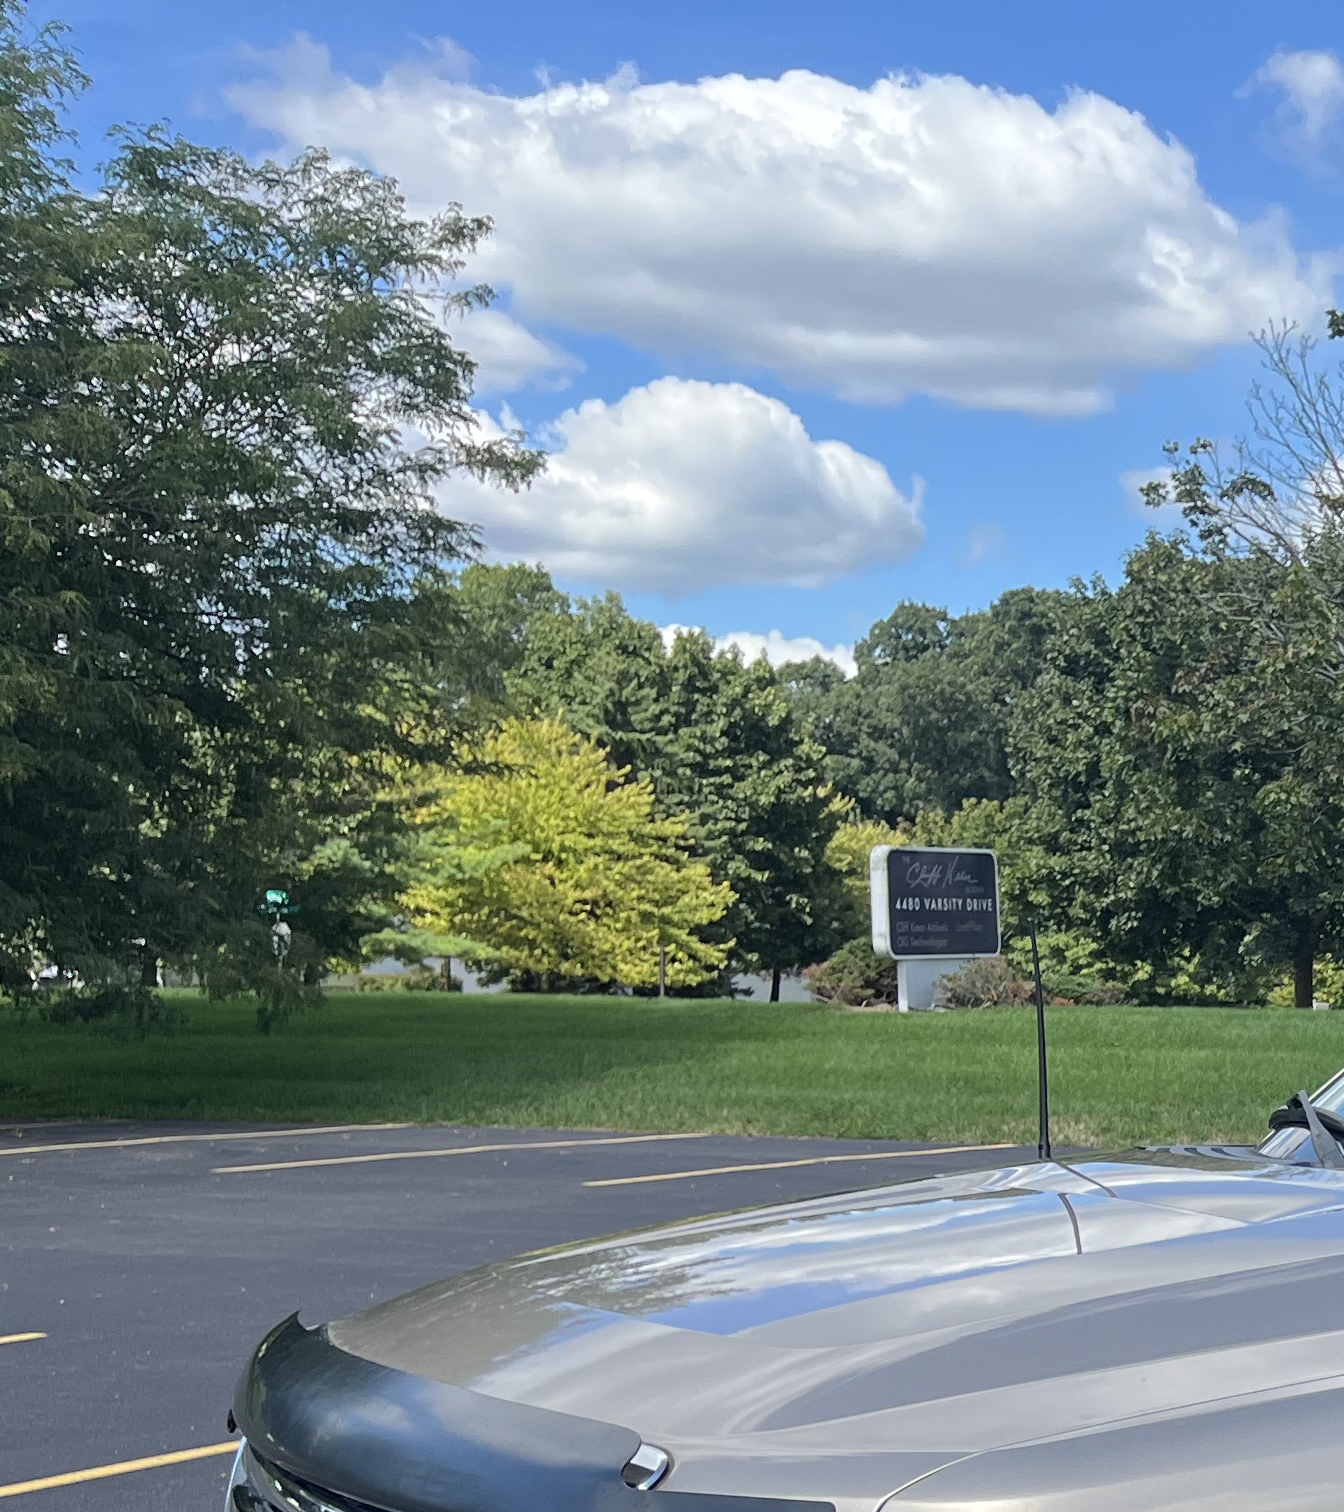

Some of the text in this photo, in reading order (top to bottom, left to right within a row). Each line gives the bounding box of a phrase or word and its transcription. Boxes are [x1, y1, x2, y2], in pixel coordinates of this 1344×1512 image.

[895, 897, 993, 912] 4480 VARSITY DRIVE
